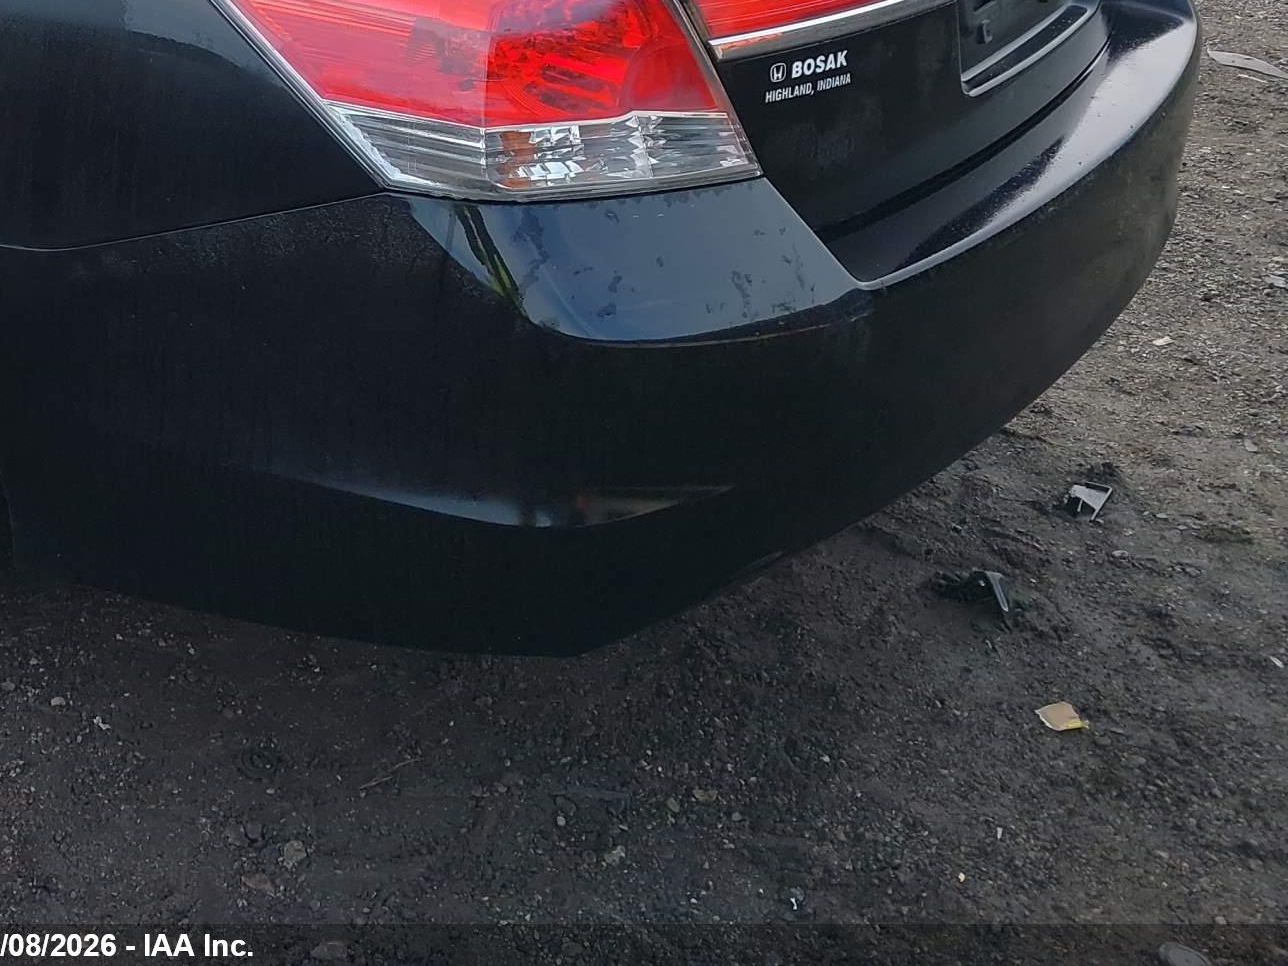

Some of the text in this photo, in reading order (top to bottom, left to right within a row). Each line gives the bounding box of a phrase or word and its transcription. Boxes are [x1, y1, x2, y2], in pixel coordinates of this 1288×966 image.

[791, 50, 848, 79] BOSAK
[765, 72, 851, 103] HIGHLAND, INDIANA
